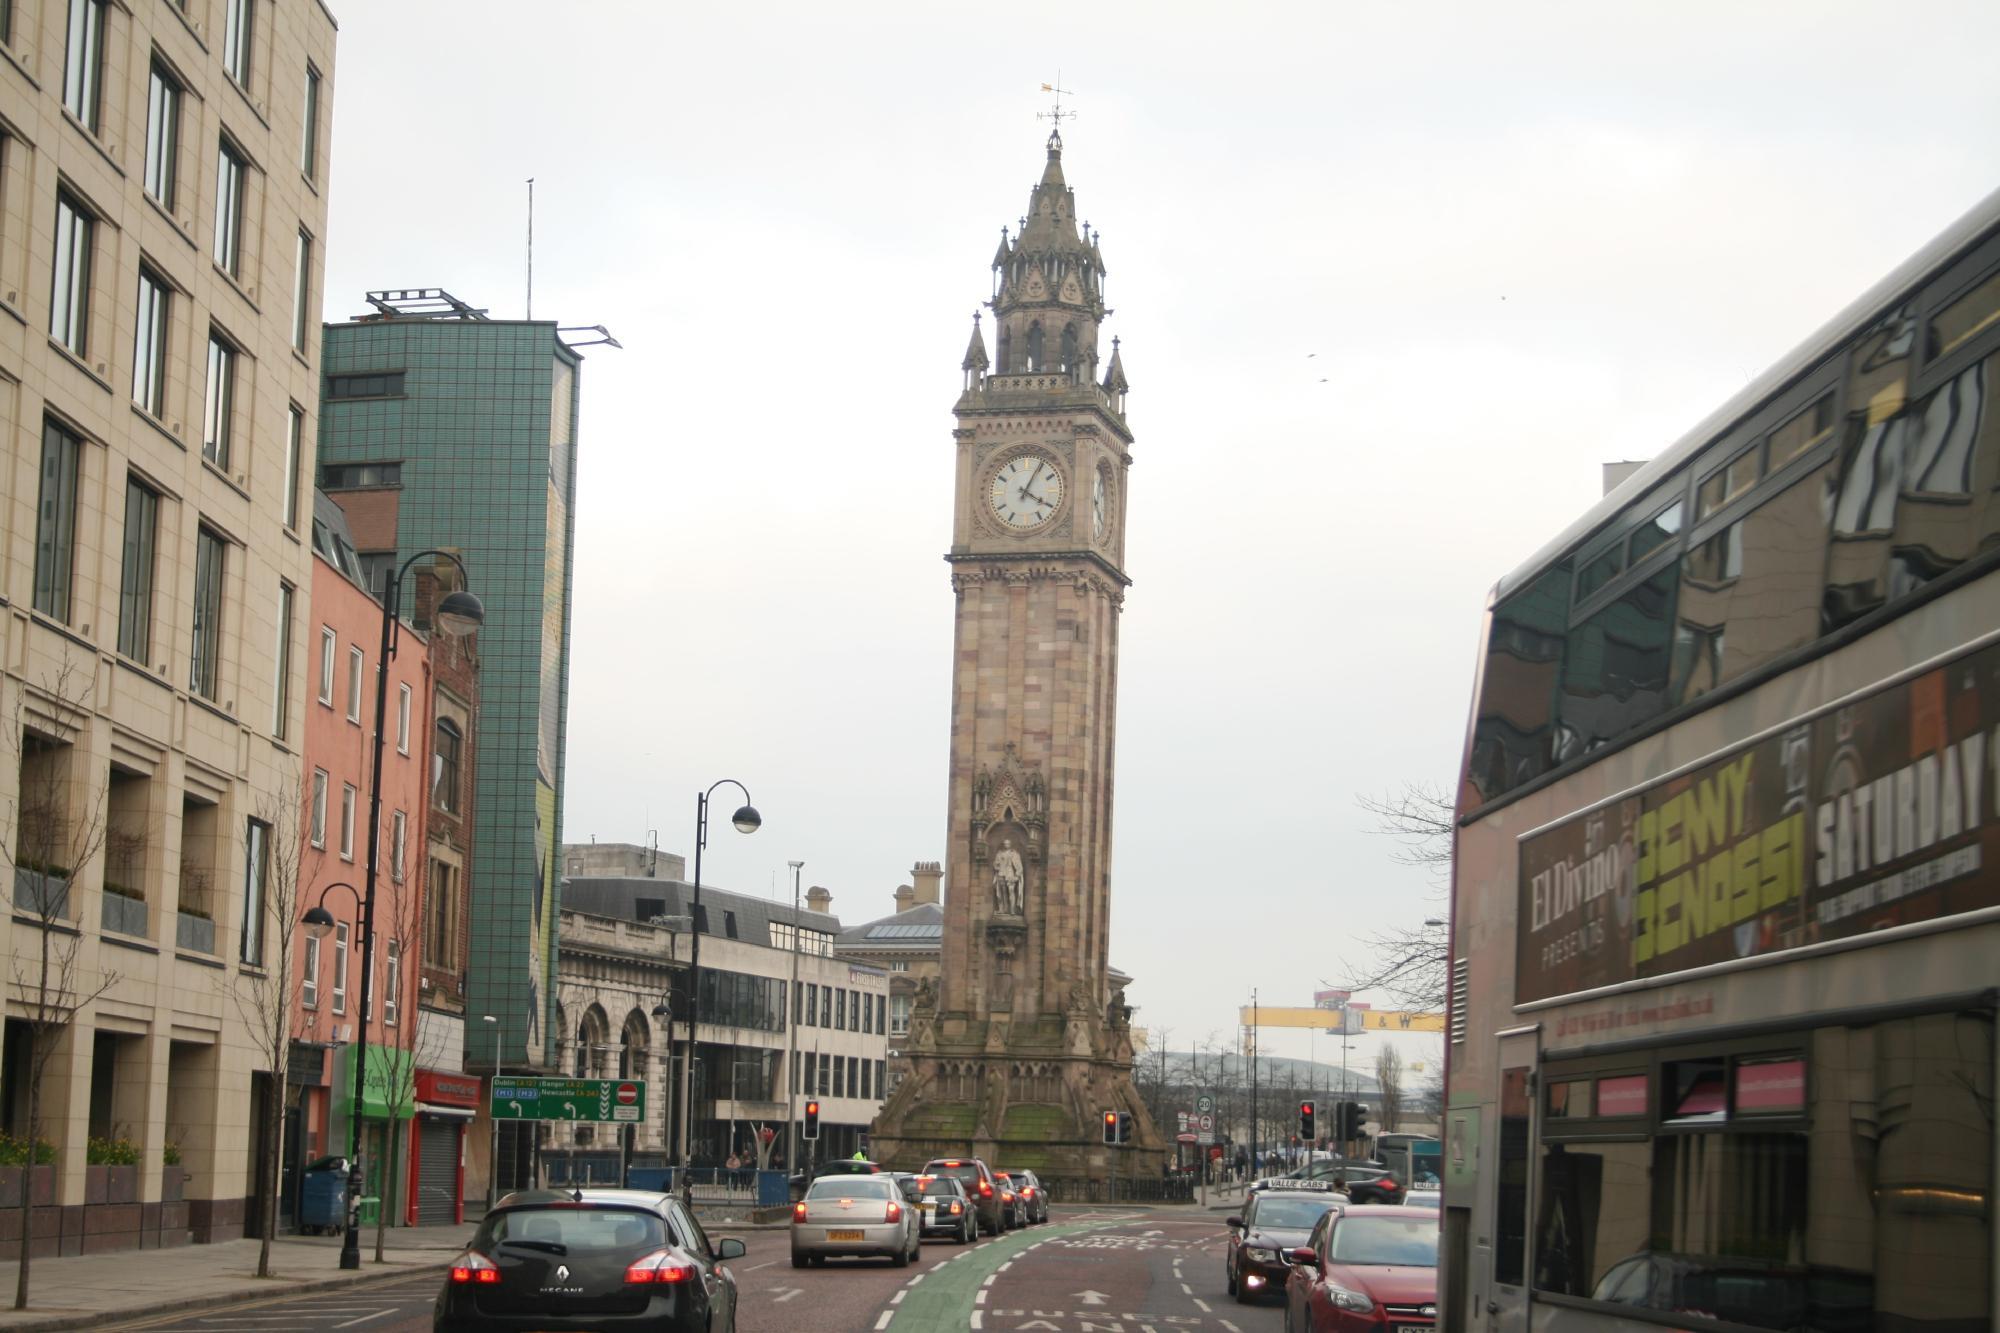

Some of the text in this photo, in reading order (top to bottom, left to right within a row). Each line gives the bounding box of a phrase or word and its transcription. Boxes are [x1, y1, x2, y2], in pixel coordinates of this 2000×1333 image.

[1817, 731, 1985, 886] SATURDAY
[1400, 1015, 1411, 1028] W
[494, 1079, 516, 1087] Dublin
